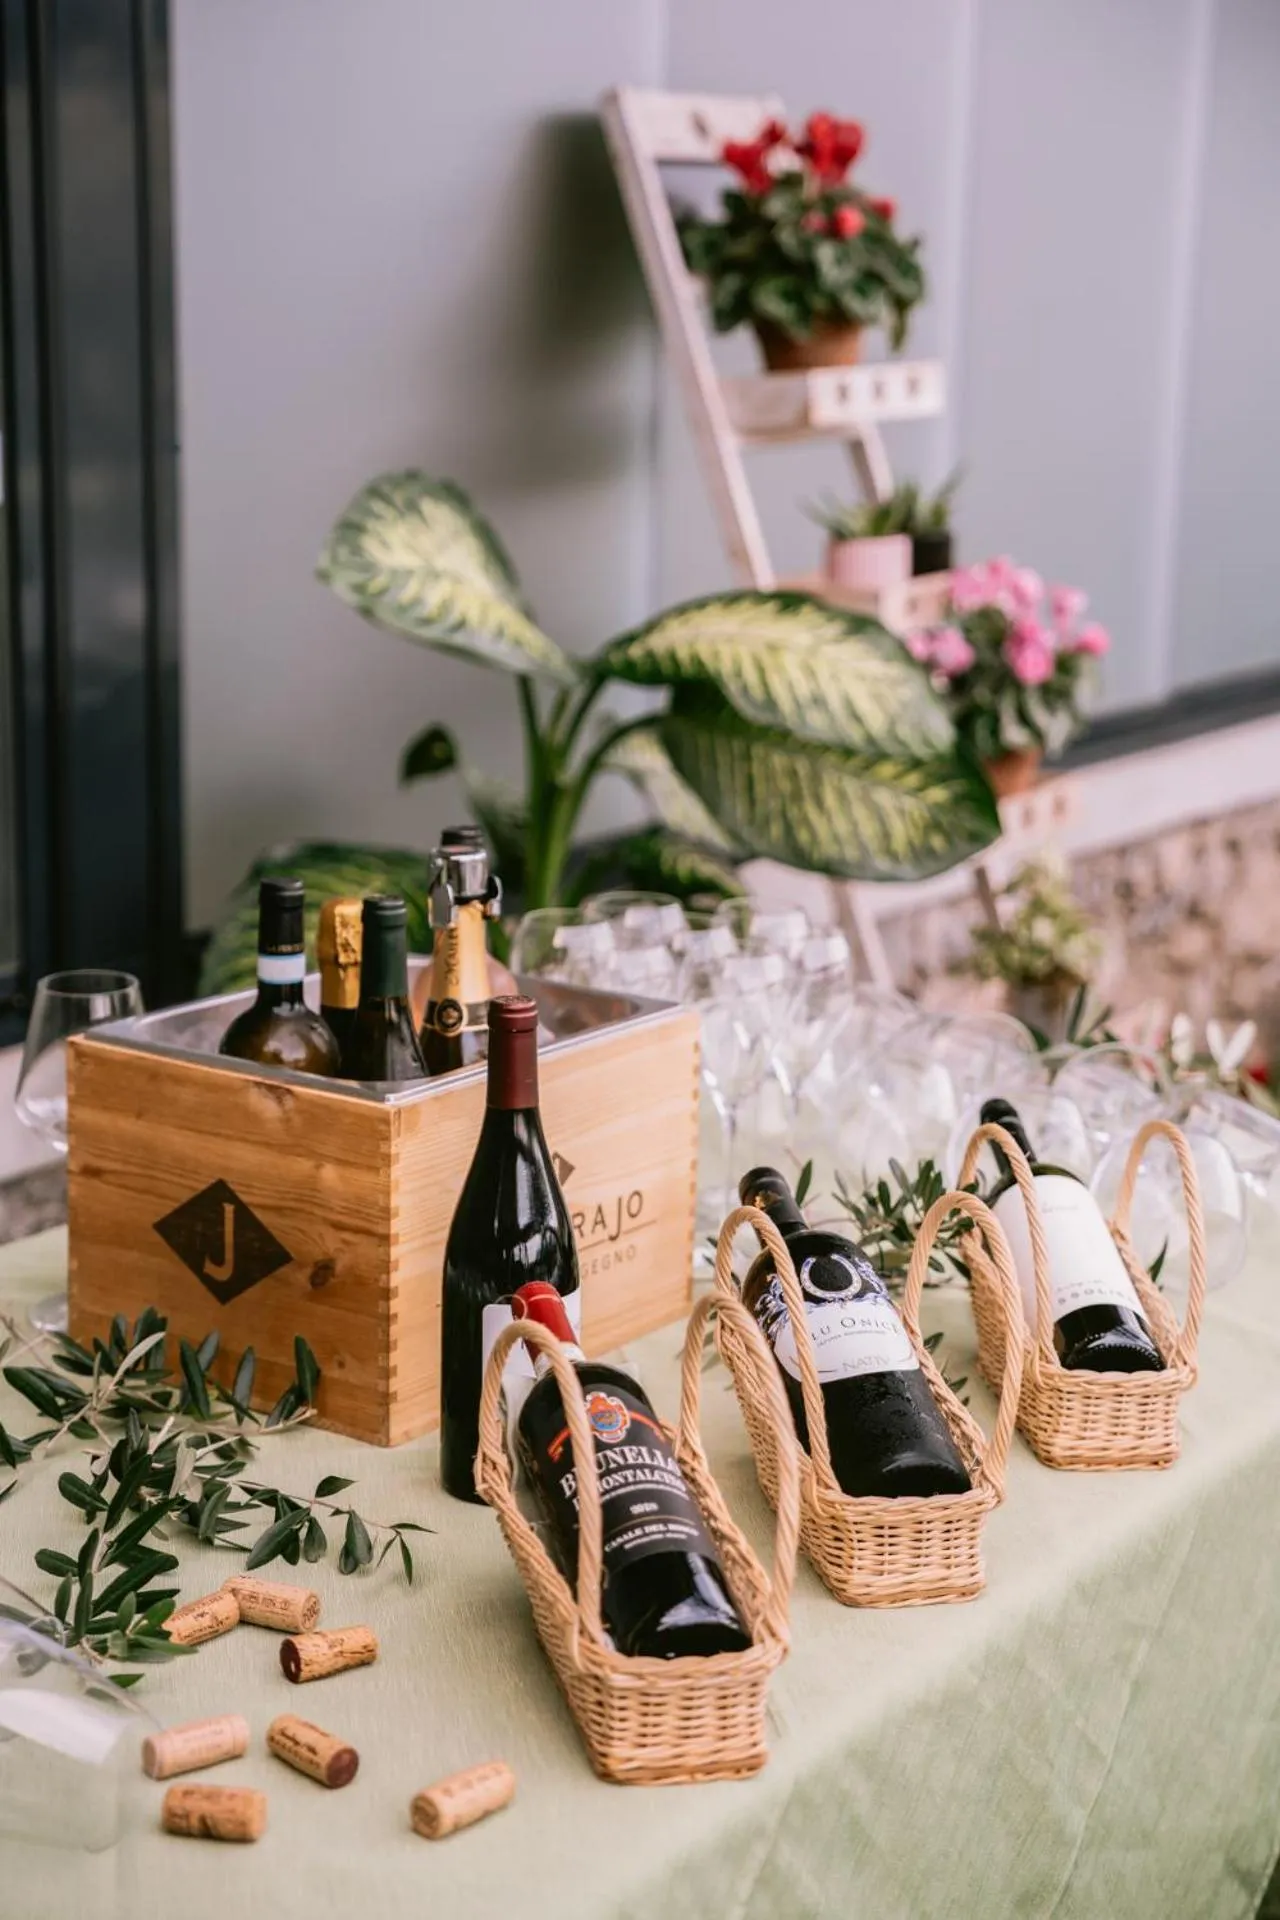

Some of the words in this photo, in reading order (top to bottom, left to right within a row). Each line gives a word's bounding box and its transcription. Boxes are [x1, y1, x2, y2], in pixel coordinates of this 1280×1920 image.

[203, 1202, 235, 1281] J
[571, 1189, 644, 1242] RAJO
[579, 1244, 636, 1278] SEGNO
[558, 1445, 682, 1498] BUNELLO
